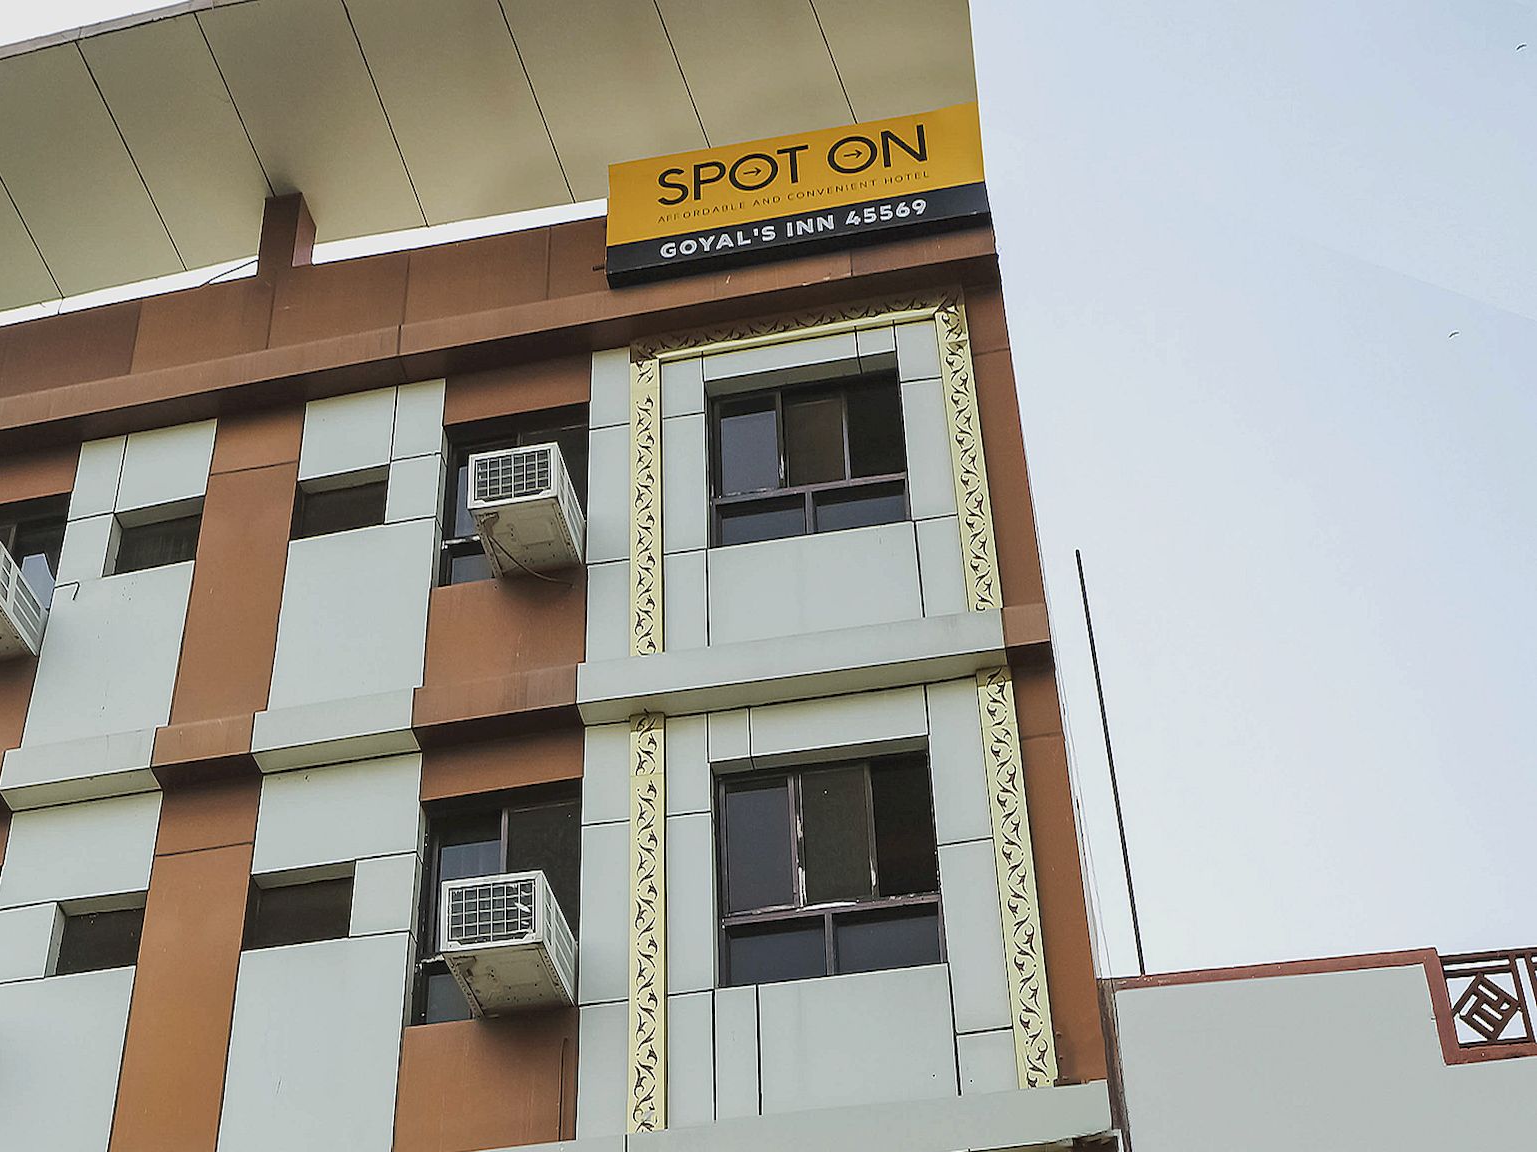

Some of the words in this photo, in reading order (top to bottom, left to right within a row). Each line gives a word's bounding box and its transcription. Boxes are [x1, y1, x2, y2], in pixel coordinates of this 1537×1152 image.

[657, 144, 809, 206] SPOT
[827, 124, 928, 174] ON
[657, 202, 745, 224] AFFORDABLE
[752, 195, 782, 207] AND
[787, 180, 877, 201] CONVENIENT
[884, 171, 929, 185] HOTEL
[660, 225, 777, 259] GOYAL'S
[786, 214, 836, 238] INN
[845, 199, 928, 226] 45569
